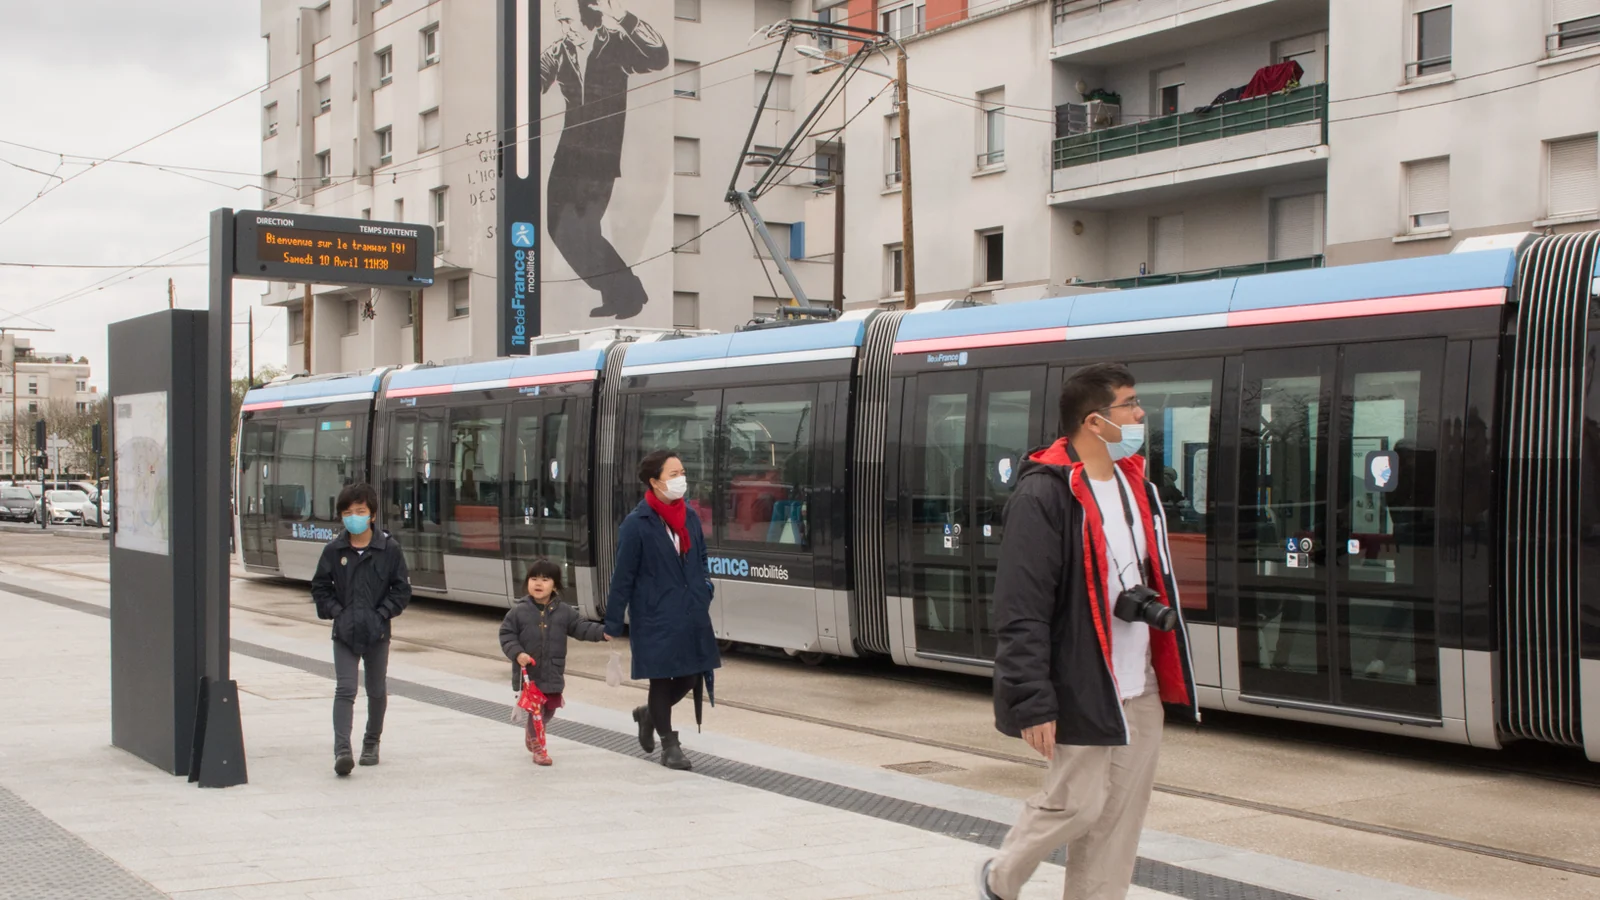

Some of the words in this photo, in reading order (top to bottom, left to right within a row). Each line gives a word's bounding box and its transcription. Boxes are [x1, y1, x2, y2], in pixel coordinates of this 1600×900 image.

[256, 216, 295, 227] DIRECTION
[359, 225, 382, 235] TEMPS
[383, 227, 418, 238] D'ATTENTE
[265, 232, 313, 247] Bienvenue
[317, 240, 333, 249] sur
[337, 238, 348, 250] le
[352, 240, 387, 253] tramway
[283, 252, 314, 265] Samedi
[319, 255, 330, 266] 10
[334, 256, 359, 268] Avril
[364, 258, 389, 270] 11H38
[526, 249, 536, 293] mobilités
[706, 556, 749, 577] rance
[750, 564, 789, 580] mobilités
